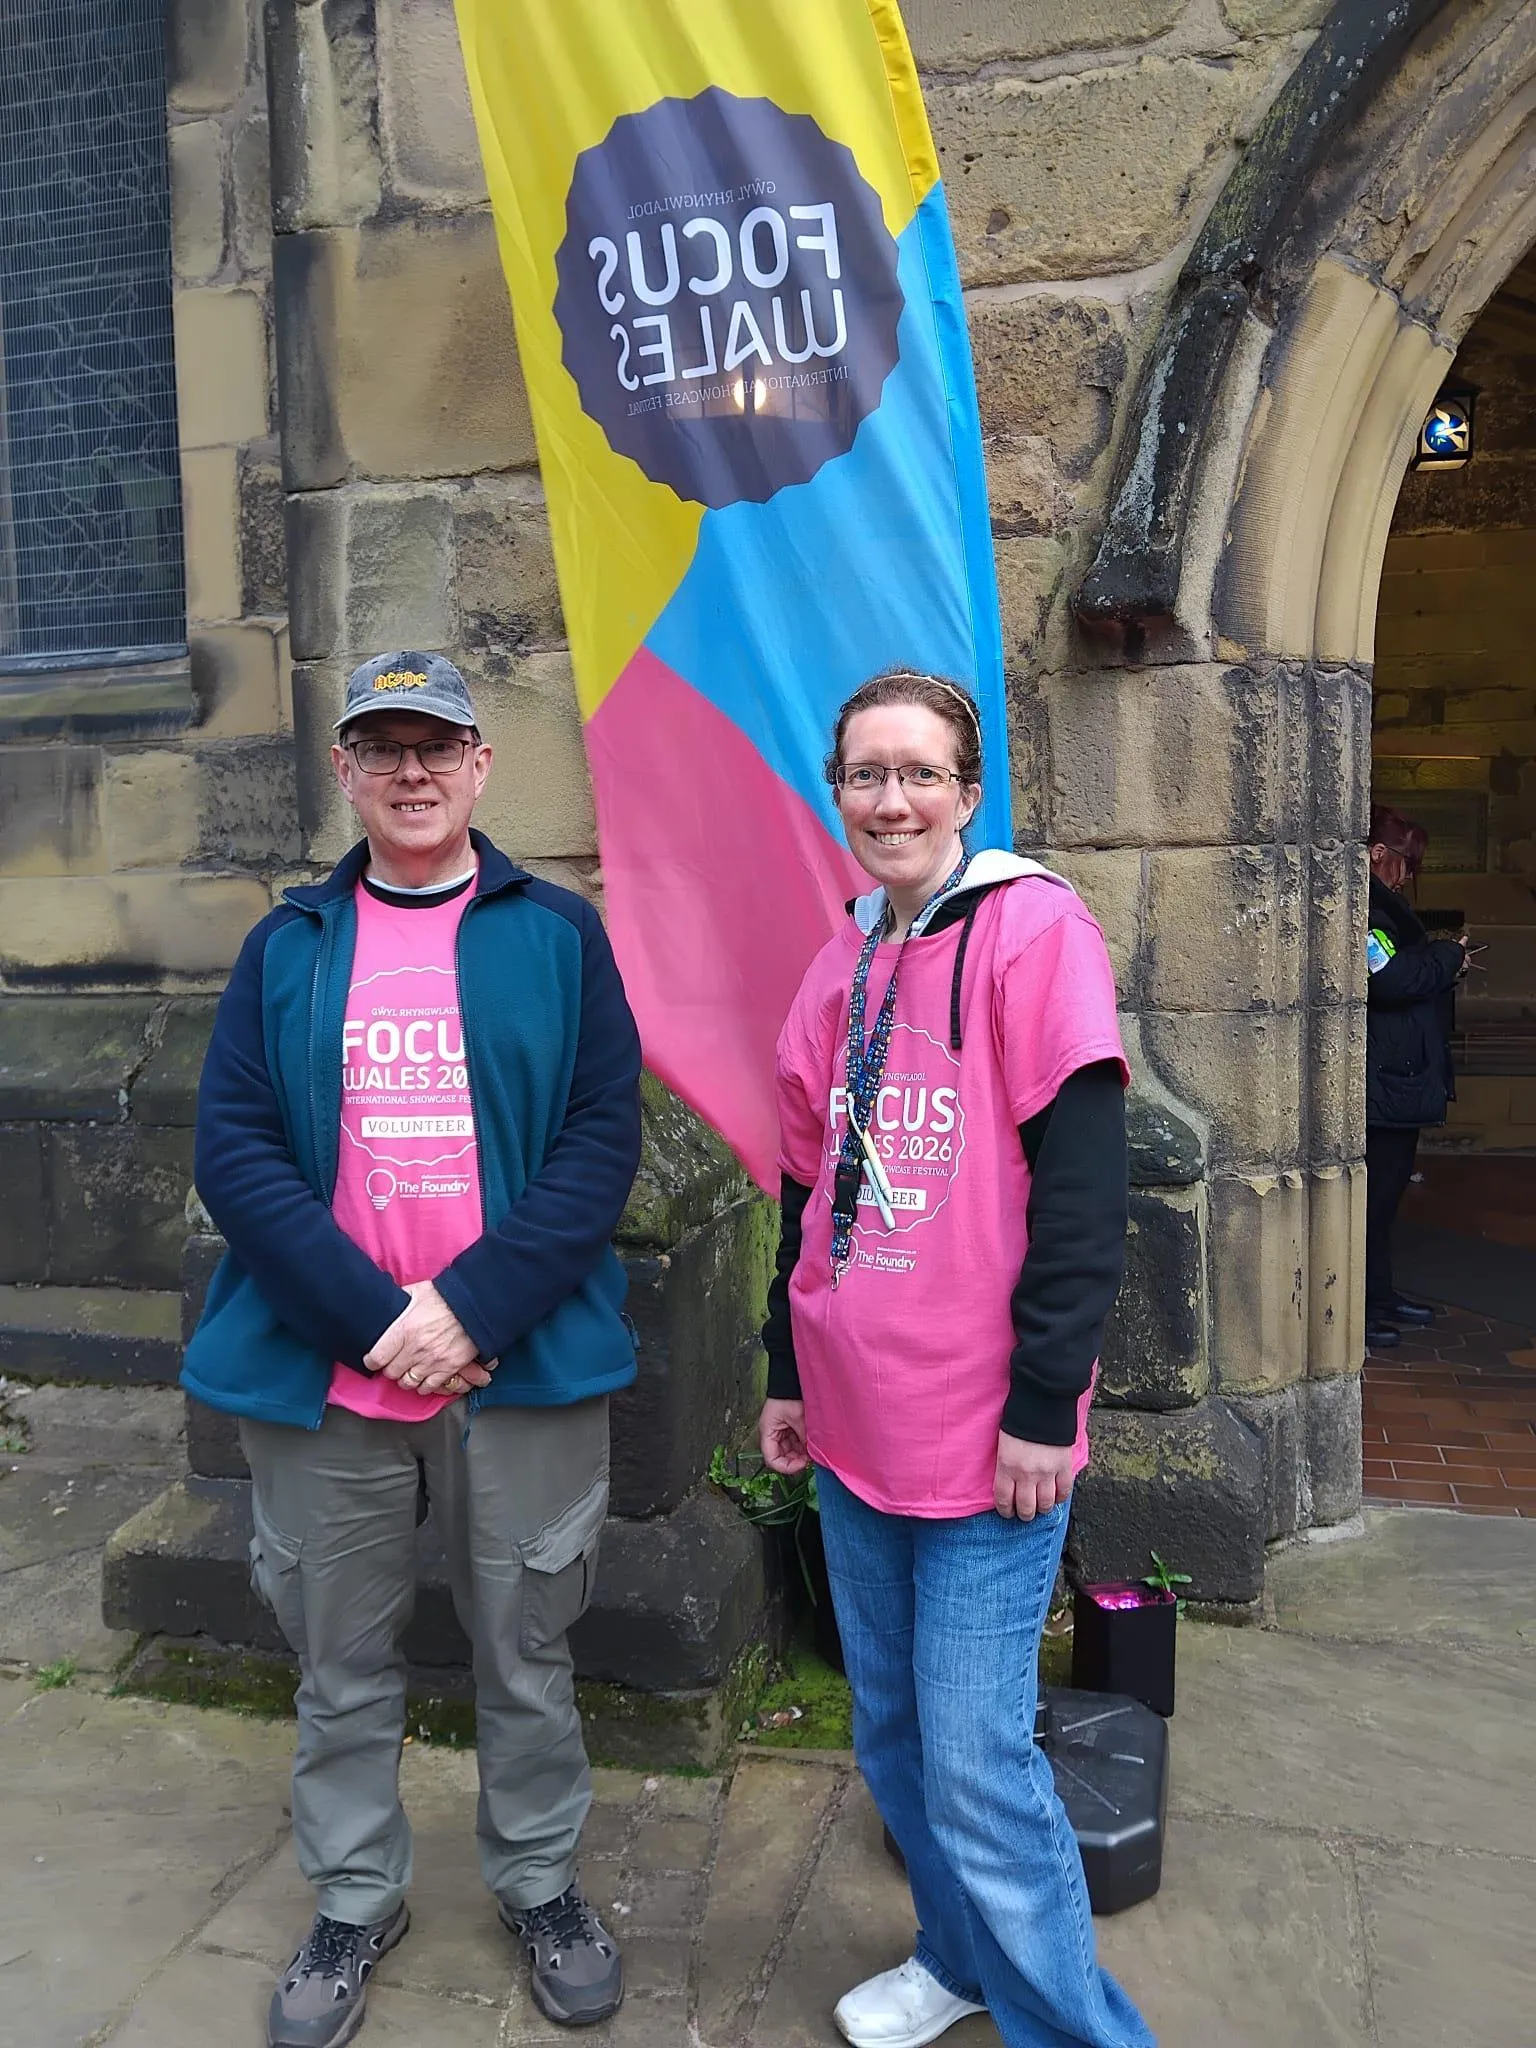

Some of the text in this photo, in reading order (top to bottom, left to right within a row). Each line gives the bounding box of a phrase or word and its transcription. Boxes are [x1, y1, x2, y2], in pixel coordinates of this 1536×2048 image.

[399, 1007, 460, 1017] RHYNGWLAD
[342, 1020, 466, 1065] FOCU
[342, 1065, 469, 1091] WALES 20
[881, 1072, 926, 1081] YNGWLADOL
[345, 1095, 408, 1105] INTERNATIONAL
[410, 1095, 456, 1104] SHOWCASE
[829, 1086, 957, 1133] FCUS
[368, 1119, 466, 1134] VOLUNTEER
[829, 1133, 951, 1162] WES 2026
[883, 1165, 949, 1177] OWCASE FESTIVAL
[397, 1180, 470, 1194] The Foundry
[857, 1188, 918, 1206] OLUEER
[858, 1250, 874, 1264] The
[876, 1253, 916, 1271] Foundry
